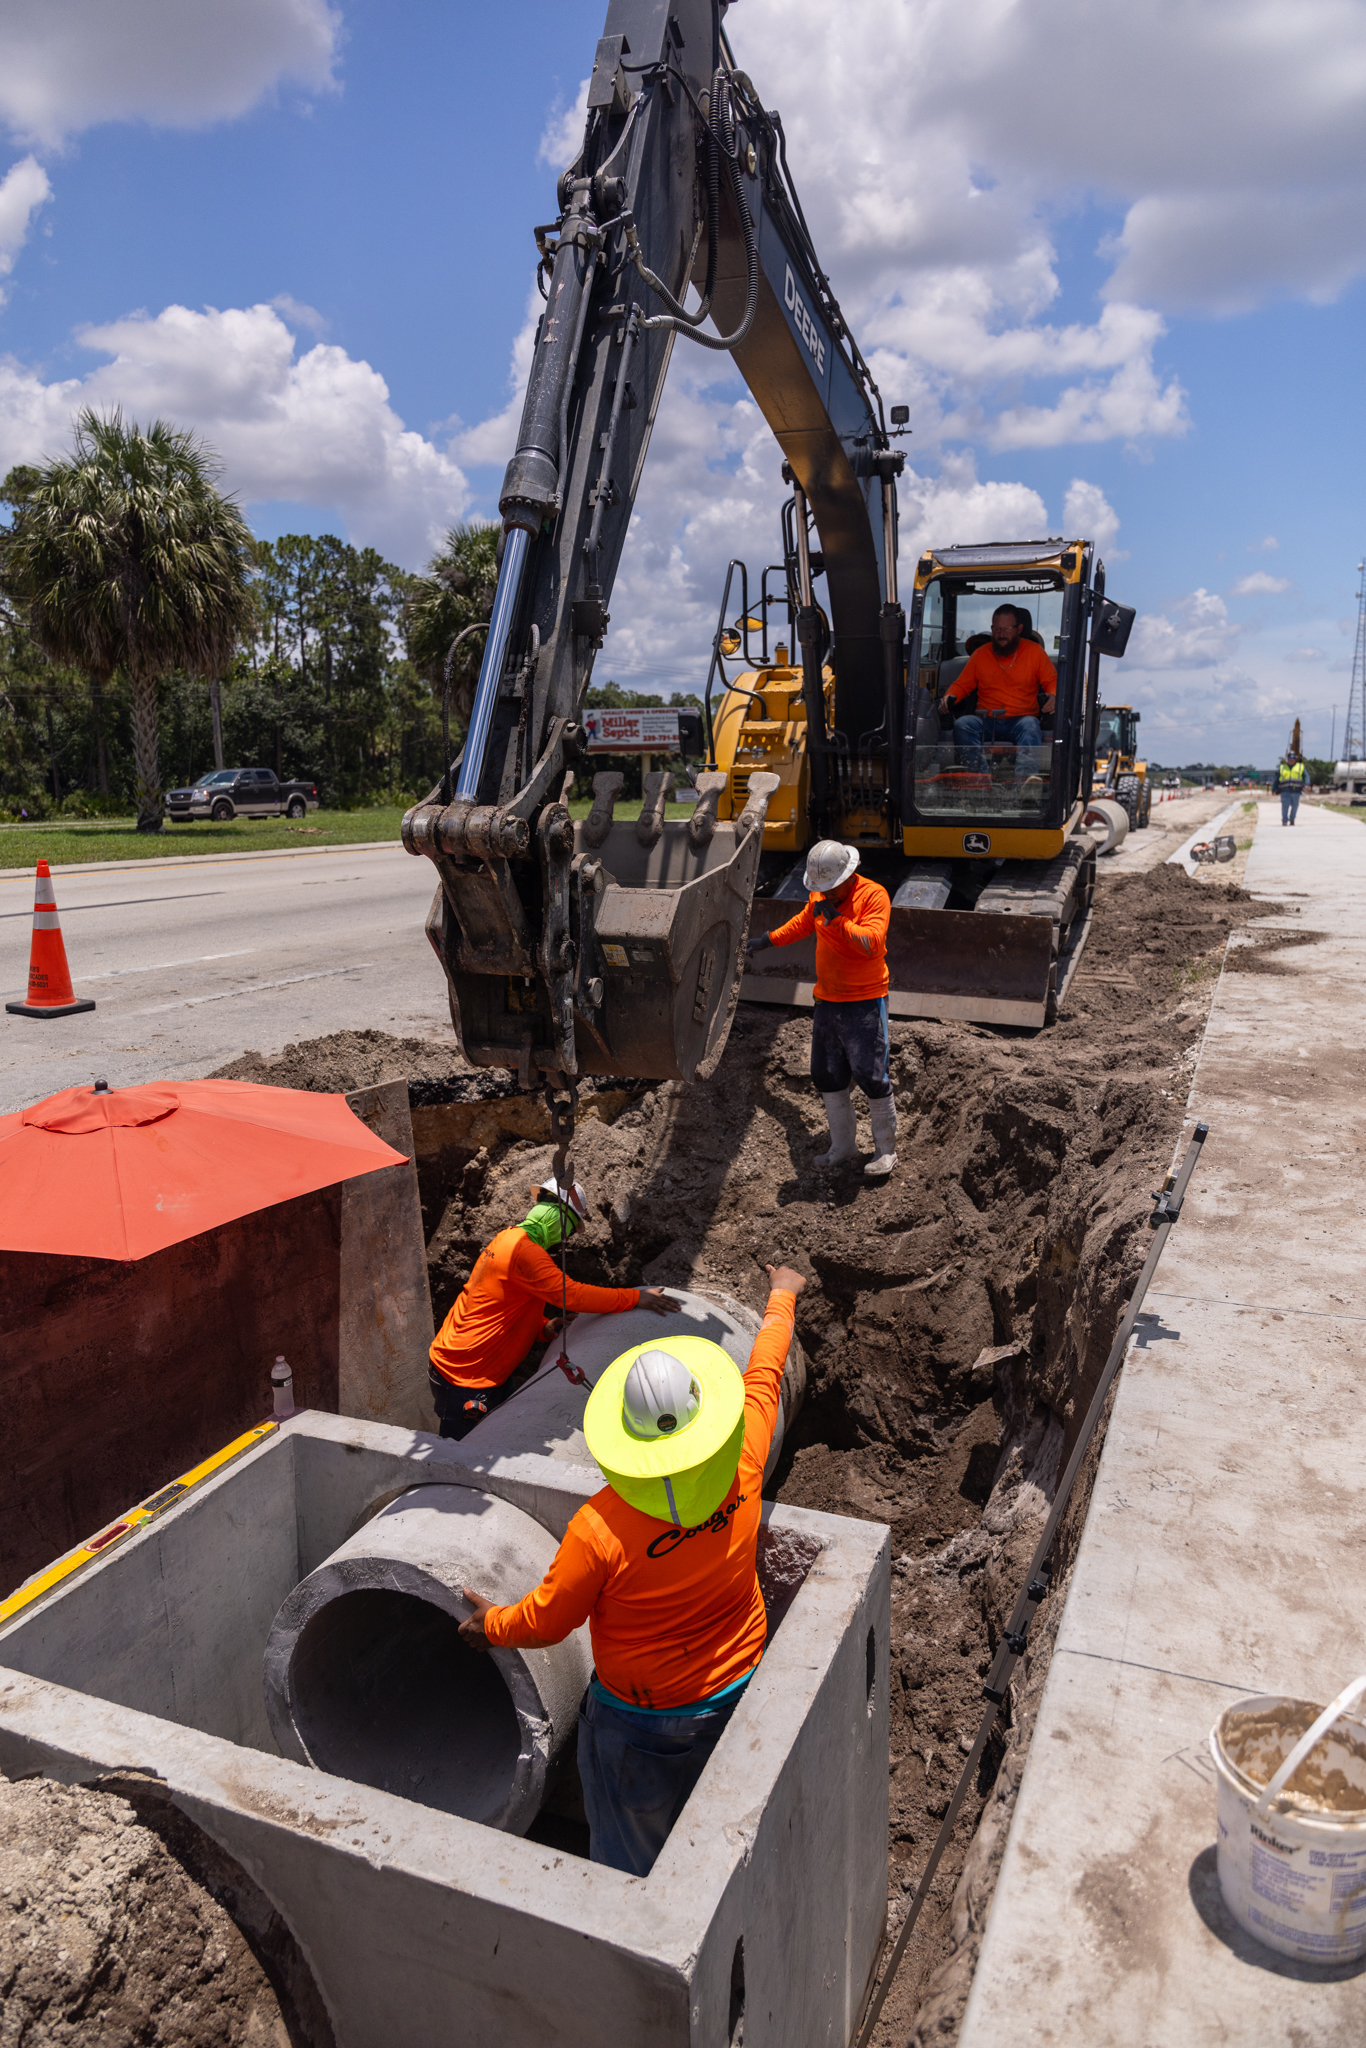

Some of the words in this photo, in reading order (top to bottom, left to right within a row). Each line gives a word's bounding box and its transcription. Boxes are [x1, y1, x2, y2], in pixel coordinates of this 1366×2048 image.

[784, 262, 825, 376] DEERE
[601, 716, 639, 728] Miller
[602, 728, 640, 740] Septic
[647, 1494, 748, 1558] Cougar
